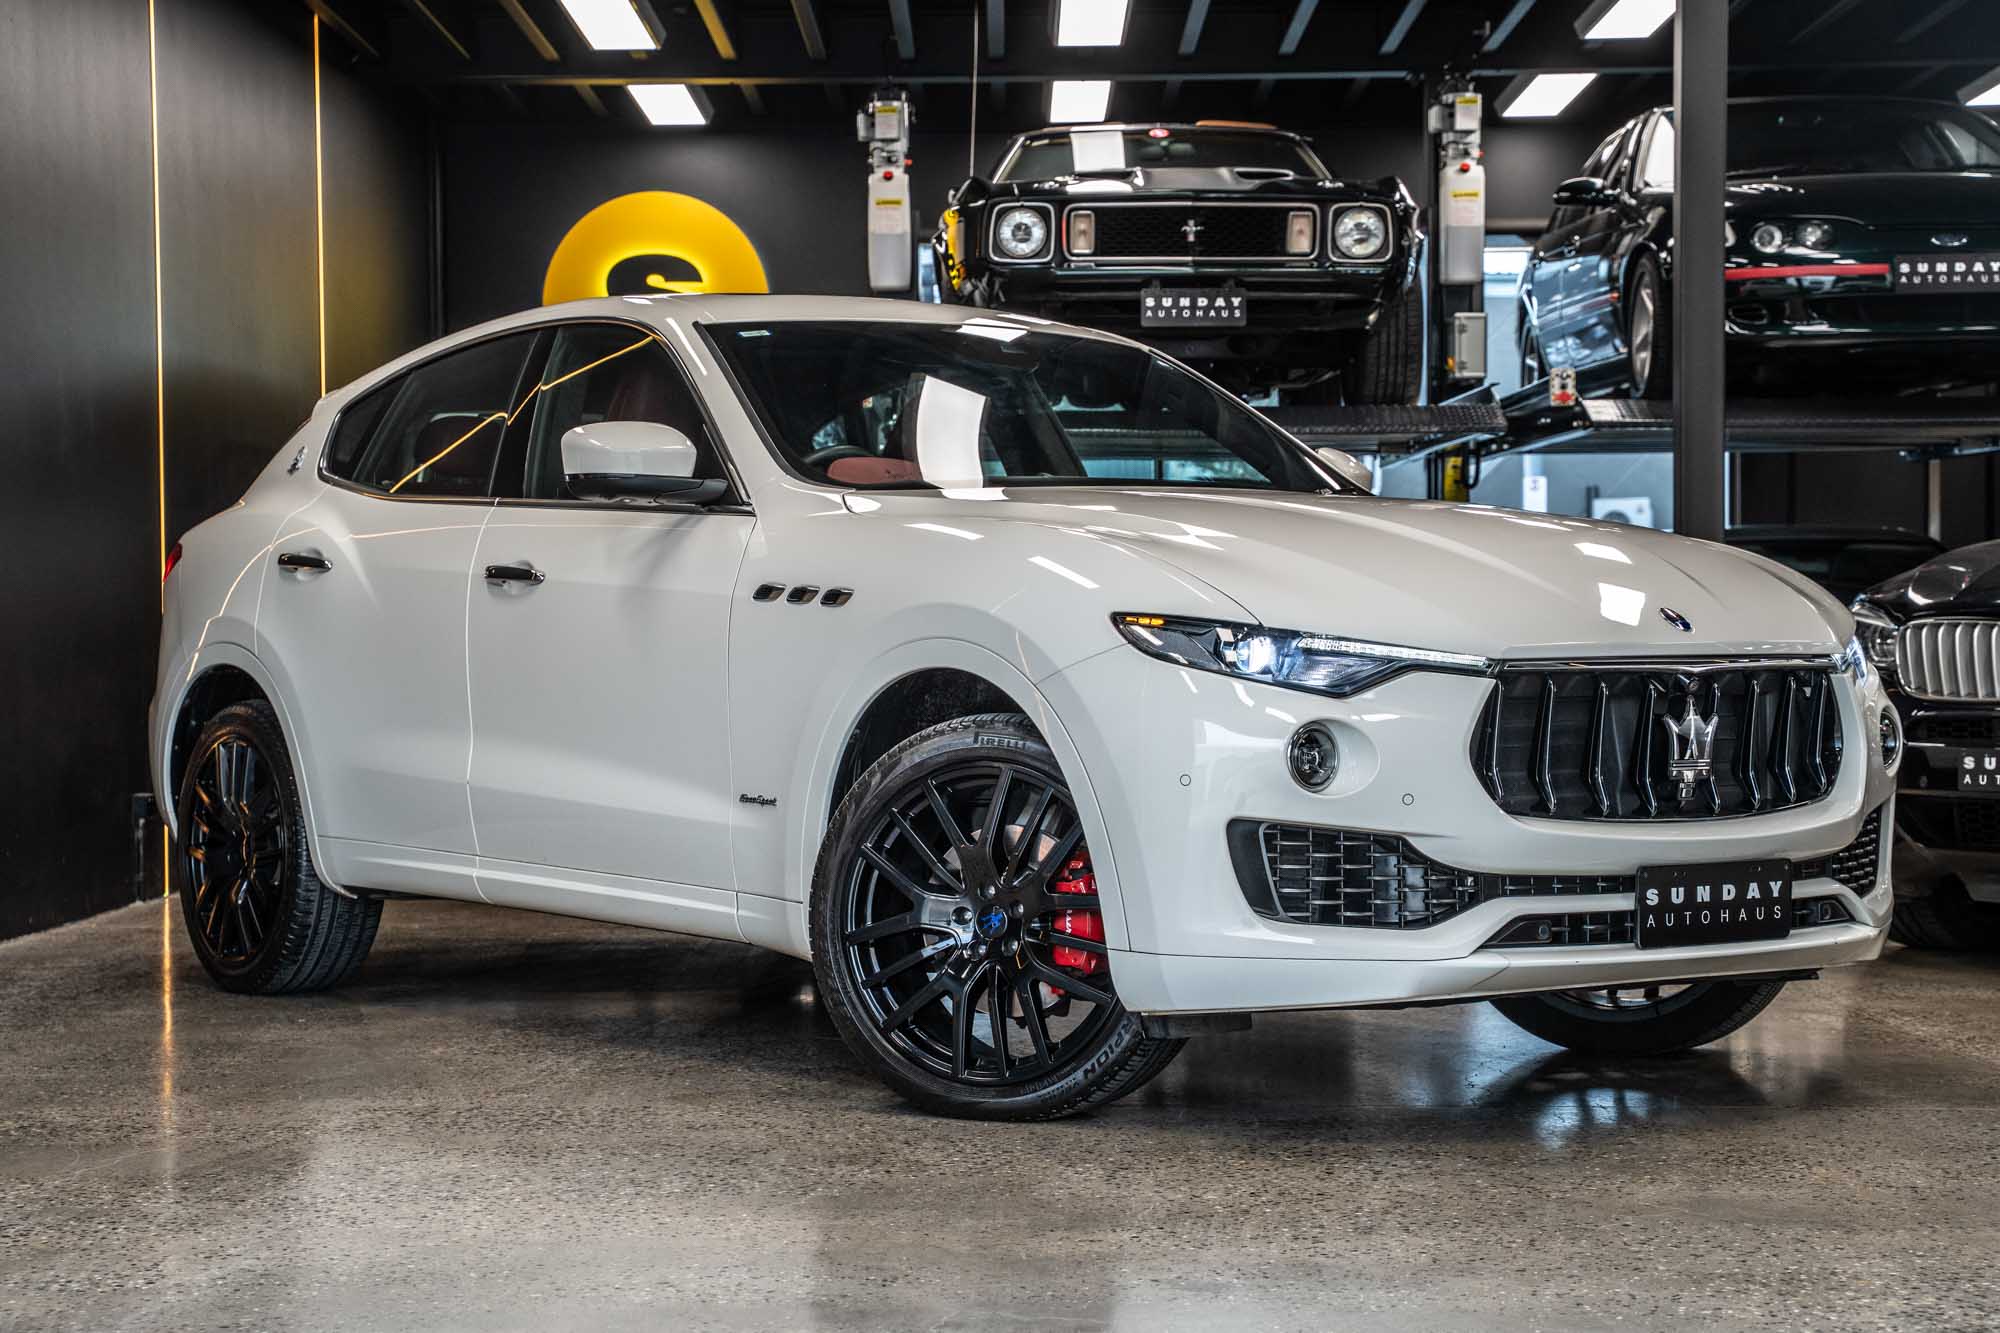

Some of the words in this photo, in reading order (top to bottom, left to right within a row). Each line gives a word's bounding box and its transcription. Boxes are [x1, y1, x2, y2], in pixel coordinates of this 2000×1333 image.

[1899, 262, 2000, 273] SUNDAY
[1145, 297, 1242, 307] SUNDAY
[1145, 309, 1241, 318] AUTOHAUS
[974, 731, 1026, 750] PIRELLI
[1645, 880, 1783, 906] SUNDAY
[1646, 905, 1782, 928] AUTOHAUS
